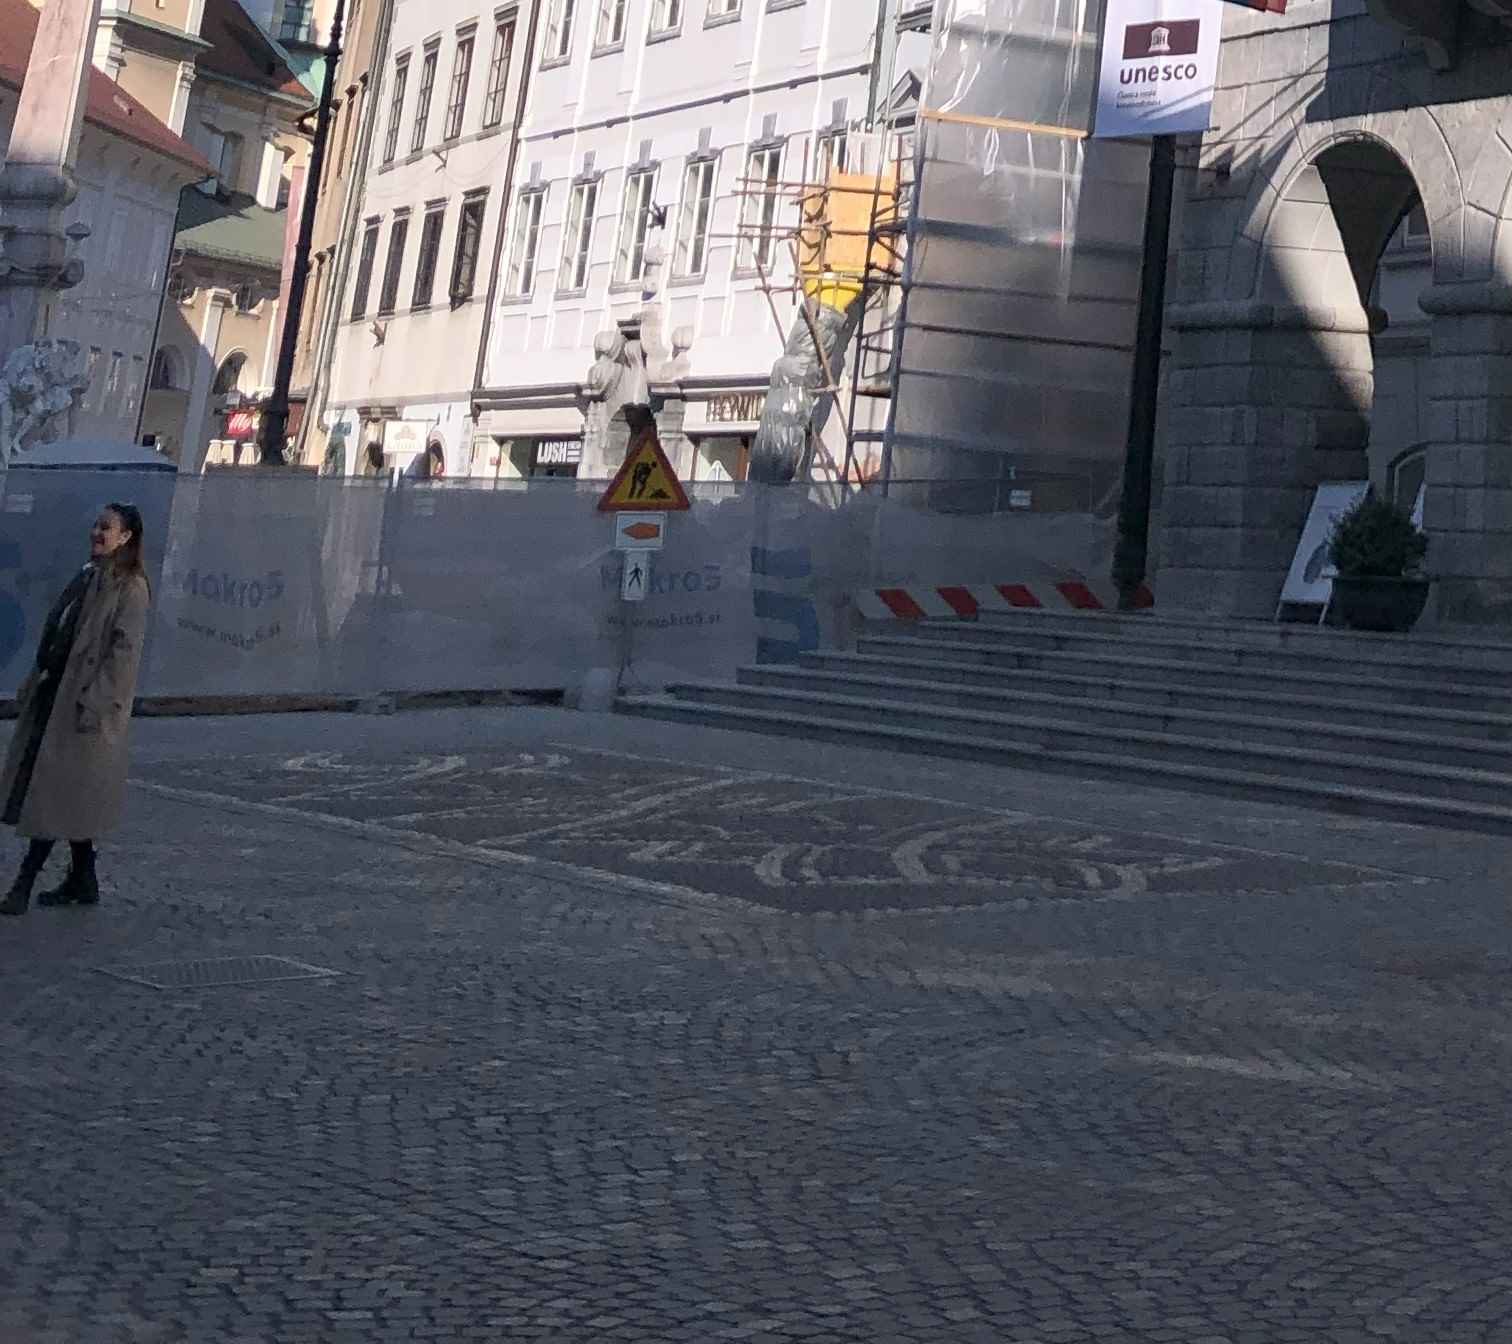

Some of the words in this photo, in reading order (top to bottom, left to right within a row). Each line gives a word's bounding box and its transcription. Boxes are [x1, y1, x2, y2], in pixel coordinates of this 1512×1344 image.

[1120, 62, 1198, 84] unesco
[537, 441, 568, 463] LUSH
[599, 563, 721, 594] Mkro5
